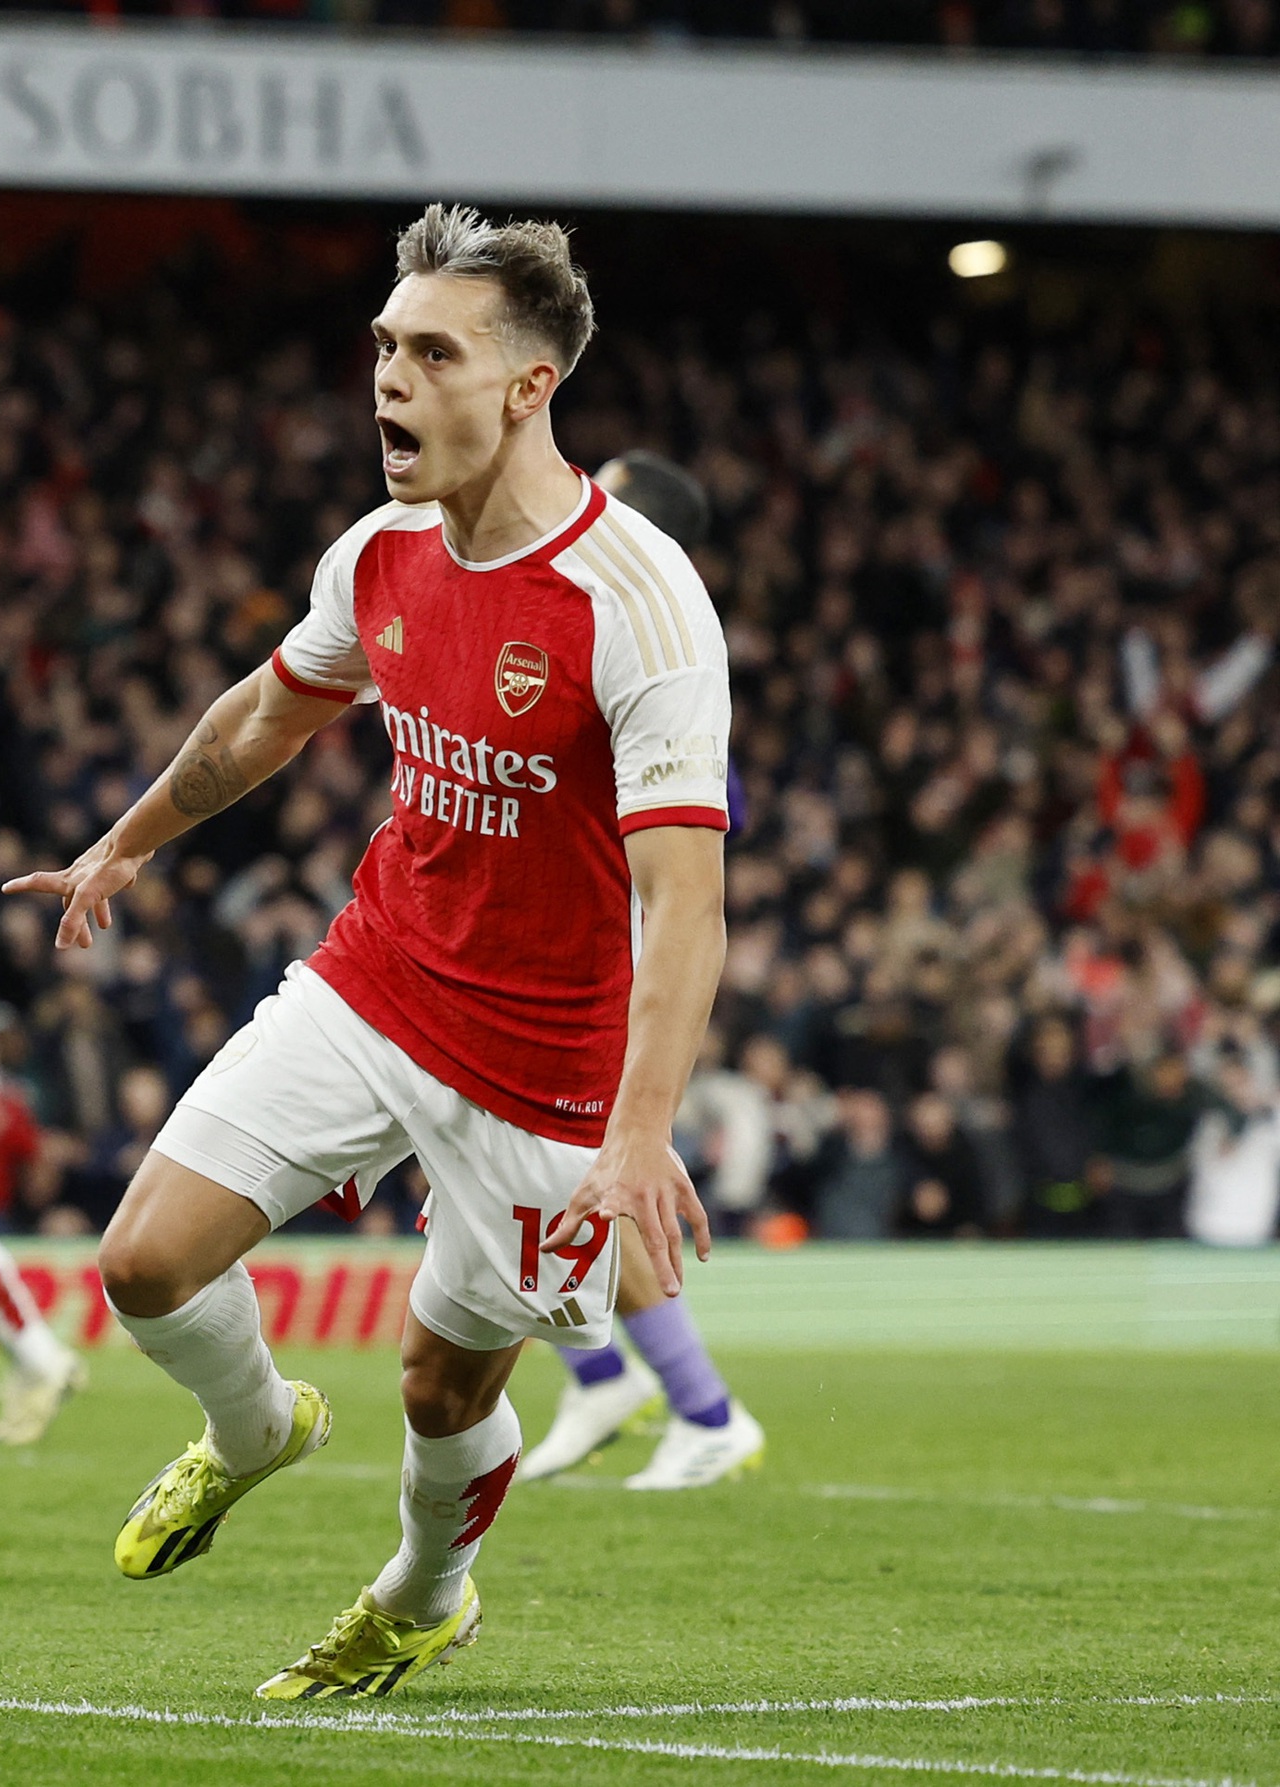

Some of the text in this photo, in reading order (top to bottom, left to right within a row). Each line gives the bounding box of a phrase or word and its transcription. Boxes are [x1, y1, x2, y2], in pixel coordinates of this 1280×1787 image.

[505, 653, 543, 671] Arsenal
[420, 773, 519, 838] BETTER
[513, 1205, 610, 1293] 19
